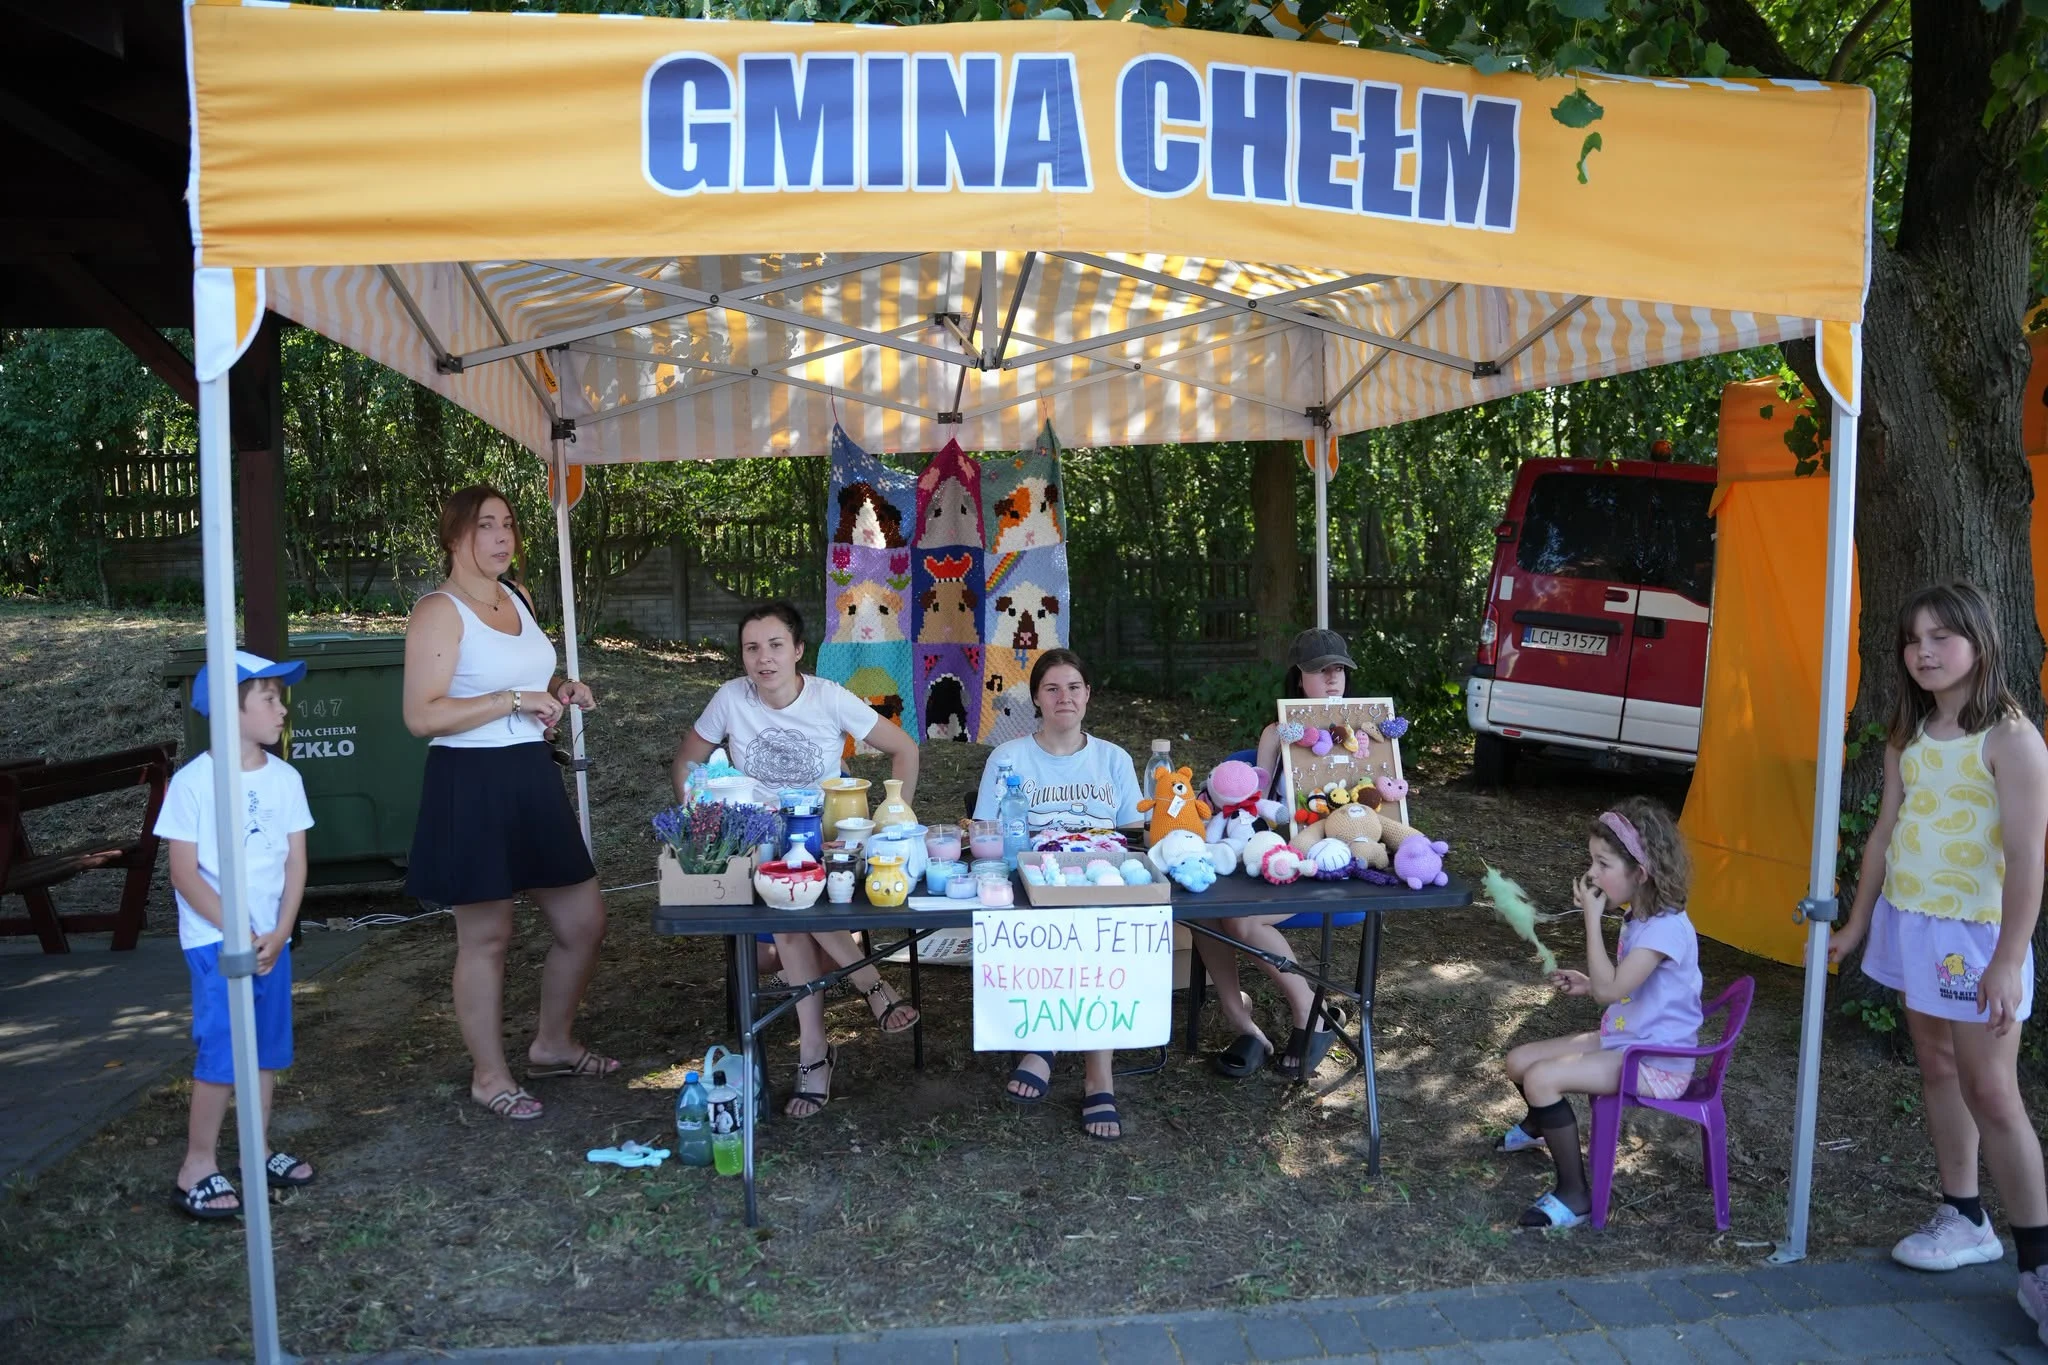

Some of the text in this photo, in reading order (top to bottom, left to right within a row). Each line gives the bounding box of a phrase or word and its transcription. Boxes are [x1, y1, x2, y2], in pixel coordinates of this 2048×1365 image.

[641, 51, 1523, 233] GMINA CHEŁM
[1532, 629, 1559, 645] LCH
[1562, 633, 1606, 650] 31577
[298, 699, 343, 717] 147
[291, 726, 357, 738] INA CHEŁM
[291, 740, 355, 759] ZKŁO
[974, 919, 1083, 954] JAGODA
[1095, 917, 1172, 955] FETTA
[982, 963, 1126, 991] RĘKODZIEŁO
[1008, 995, 1141, 1039] JANÓW
